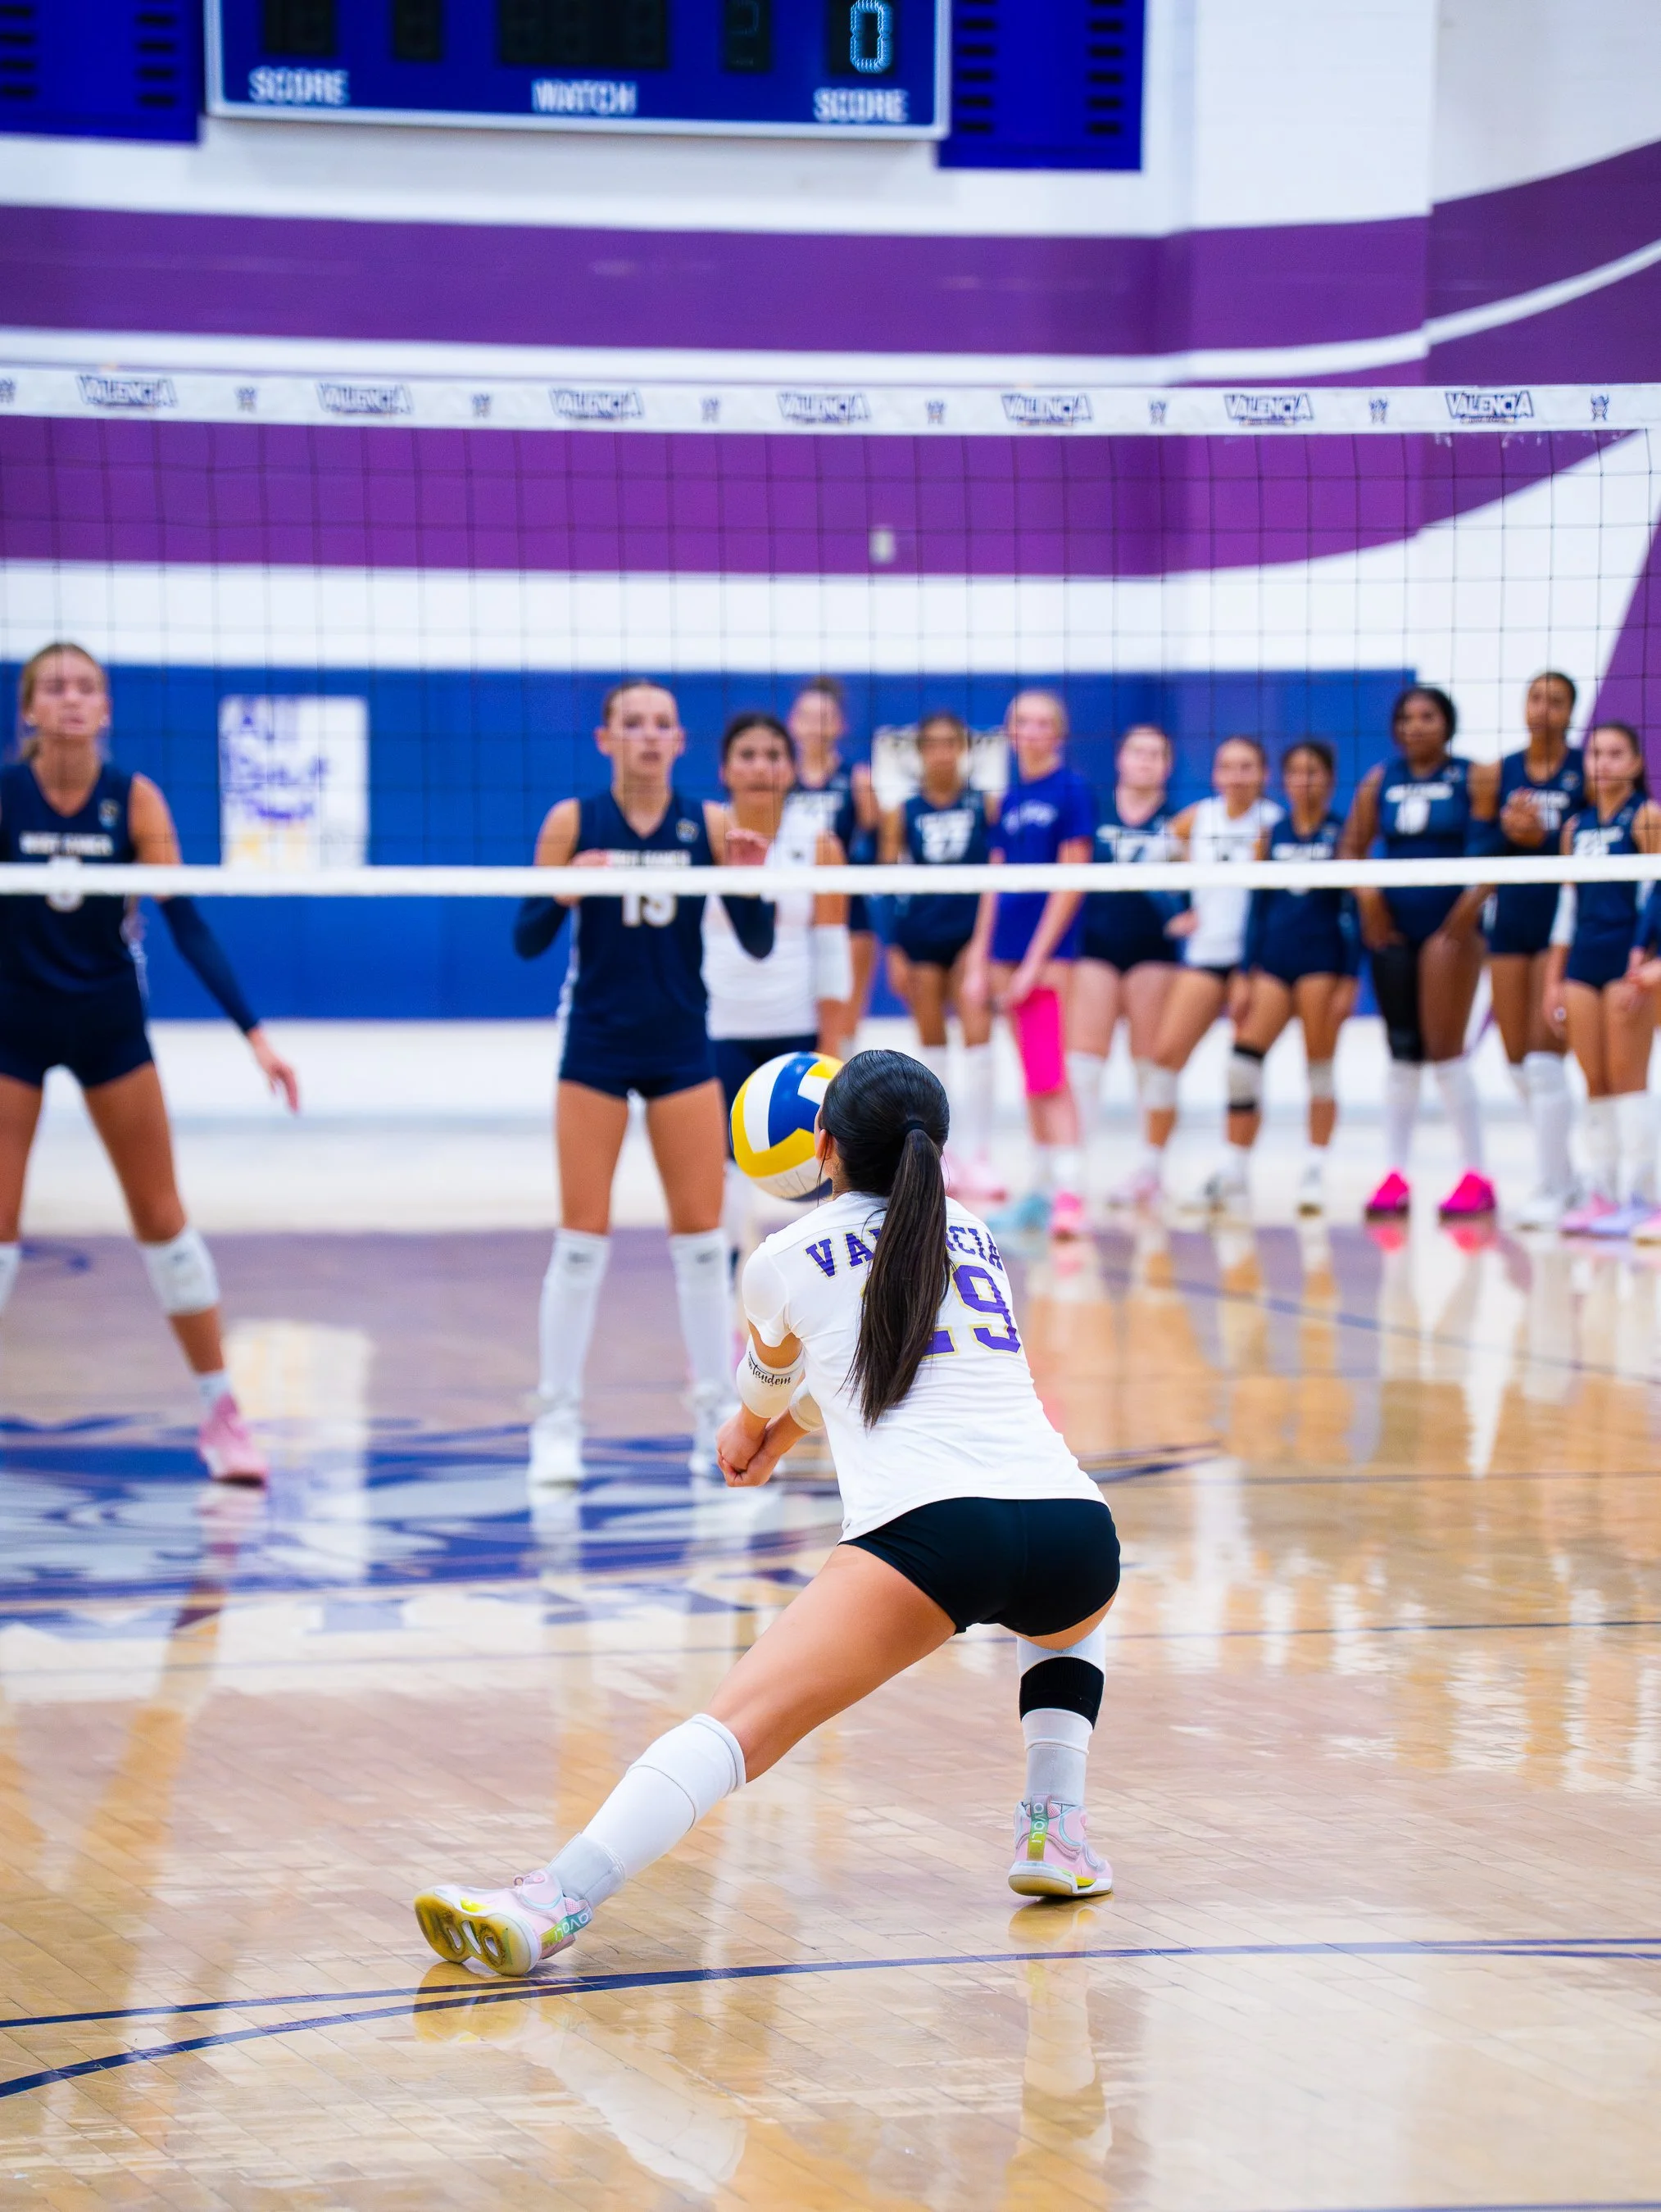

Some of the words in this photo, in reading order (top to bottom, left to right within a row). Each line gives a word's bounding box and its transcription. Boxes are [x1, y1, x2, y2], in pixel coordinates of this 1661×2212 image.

[850, 0, 893, 73] 0
[248, 66, 350, 104] SCORE
[814, 88, 908, 123] SCORE
[1224, 393, 1314, 420] VALENCIA
[1445, 390, 1534, 418] VALENCIA
[804, 1226, 1004, 1279] VACIA
[749, 1351, 791, 1386] Tandem
